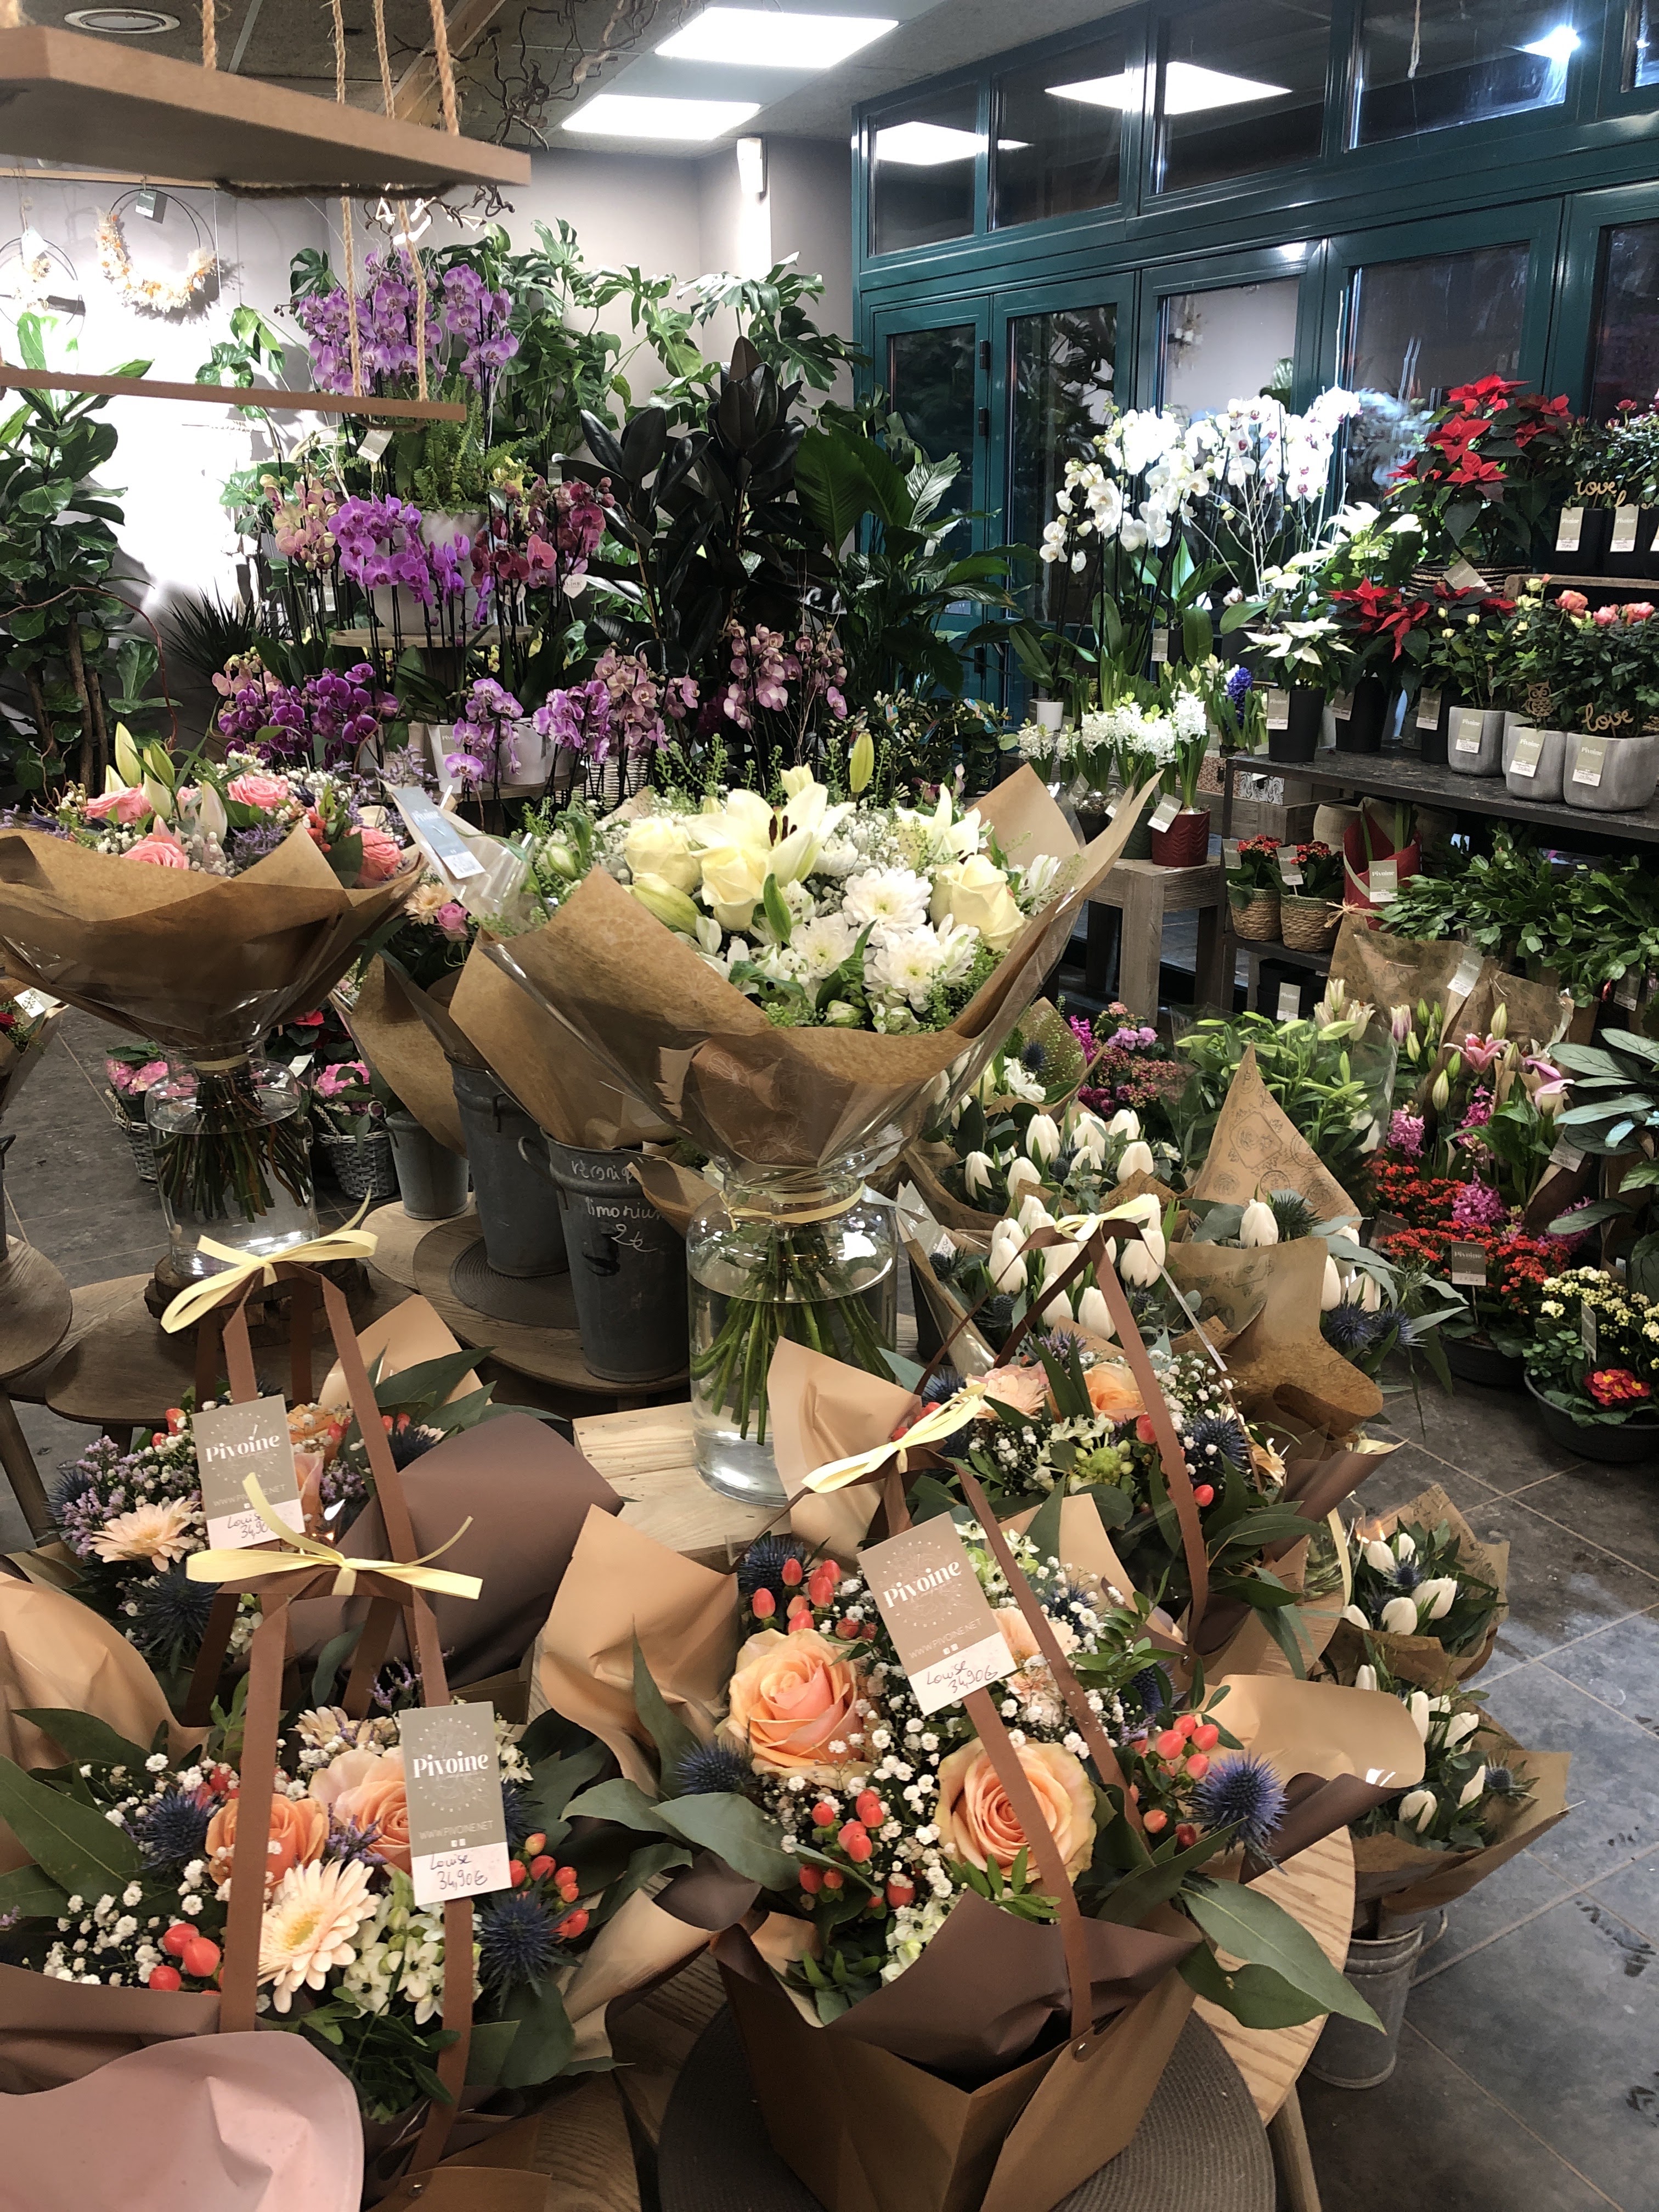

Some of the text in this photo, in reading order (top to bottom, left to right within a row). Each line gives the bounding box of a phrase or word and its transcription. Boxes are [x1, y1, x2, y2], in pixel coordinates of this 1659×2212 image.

[1582, 702, 1634, 731] love
[205, 1435, 280, 1463] Pivoine
[882, 1561, 963, 1609] Pivoine
[927, 1660, 968, 1685] Louise
[948, 1664, 998, 1694] 34,90€
[413, 1750, 489, 1779] Pivoine
[430, 1853, 472, 1870] Louise
[437, 1869, 488, 1891] 34,90€
